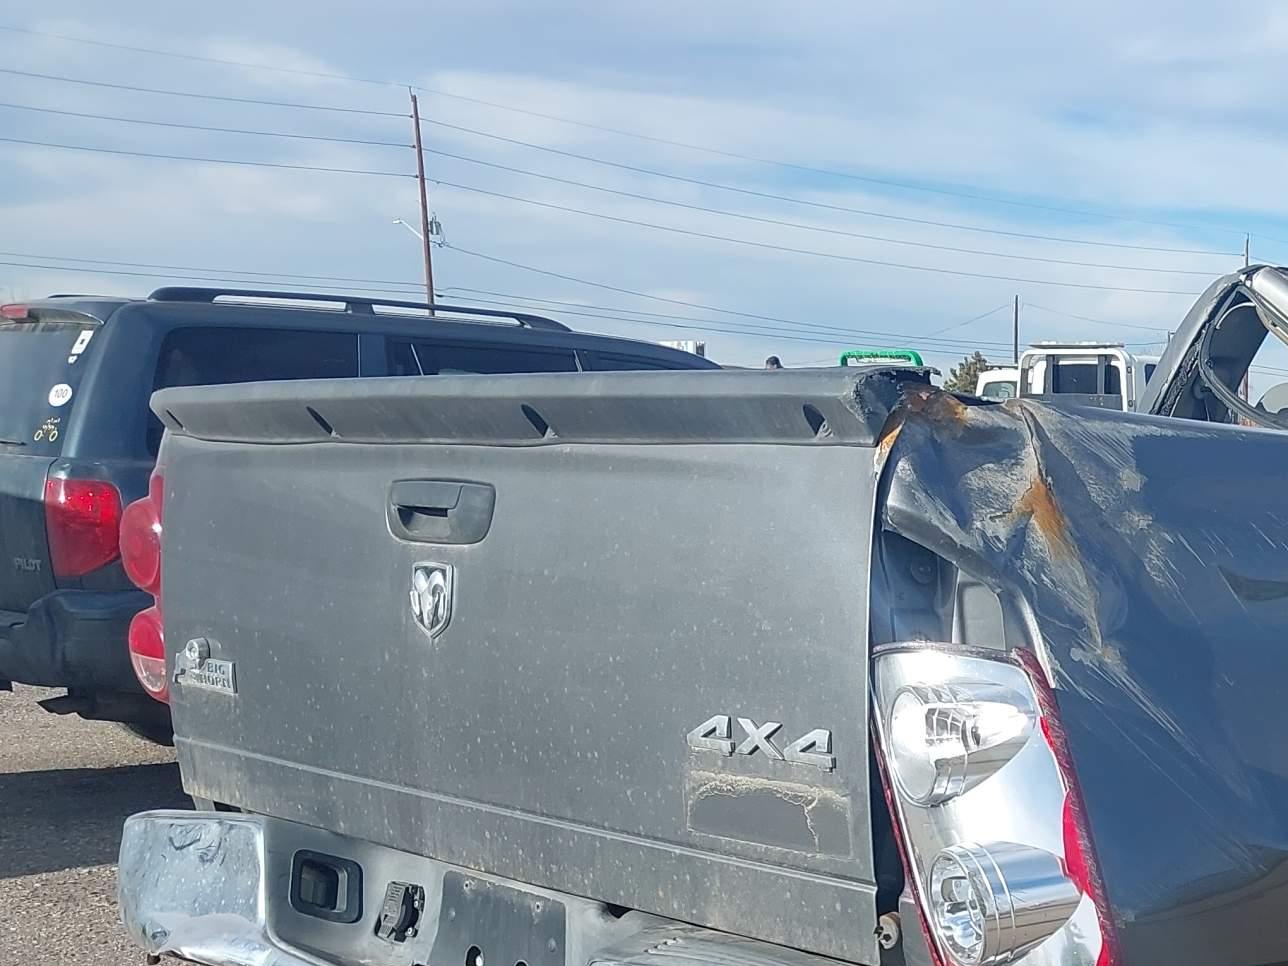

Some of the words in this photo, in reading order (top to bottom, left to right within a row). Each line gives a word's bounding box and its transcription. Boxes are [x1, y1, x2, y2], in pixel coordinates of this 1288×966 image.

[14, 557, 42, 572] PILOT
[207, 662, 225, 675] BIG
[687, 714, 836, 774] 4X4
